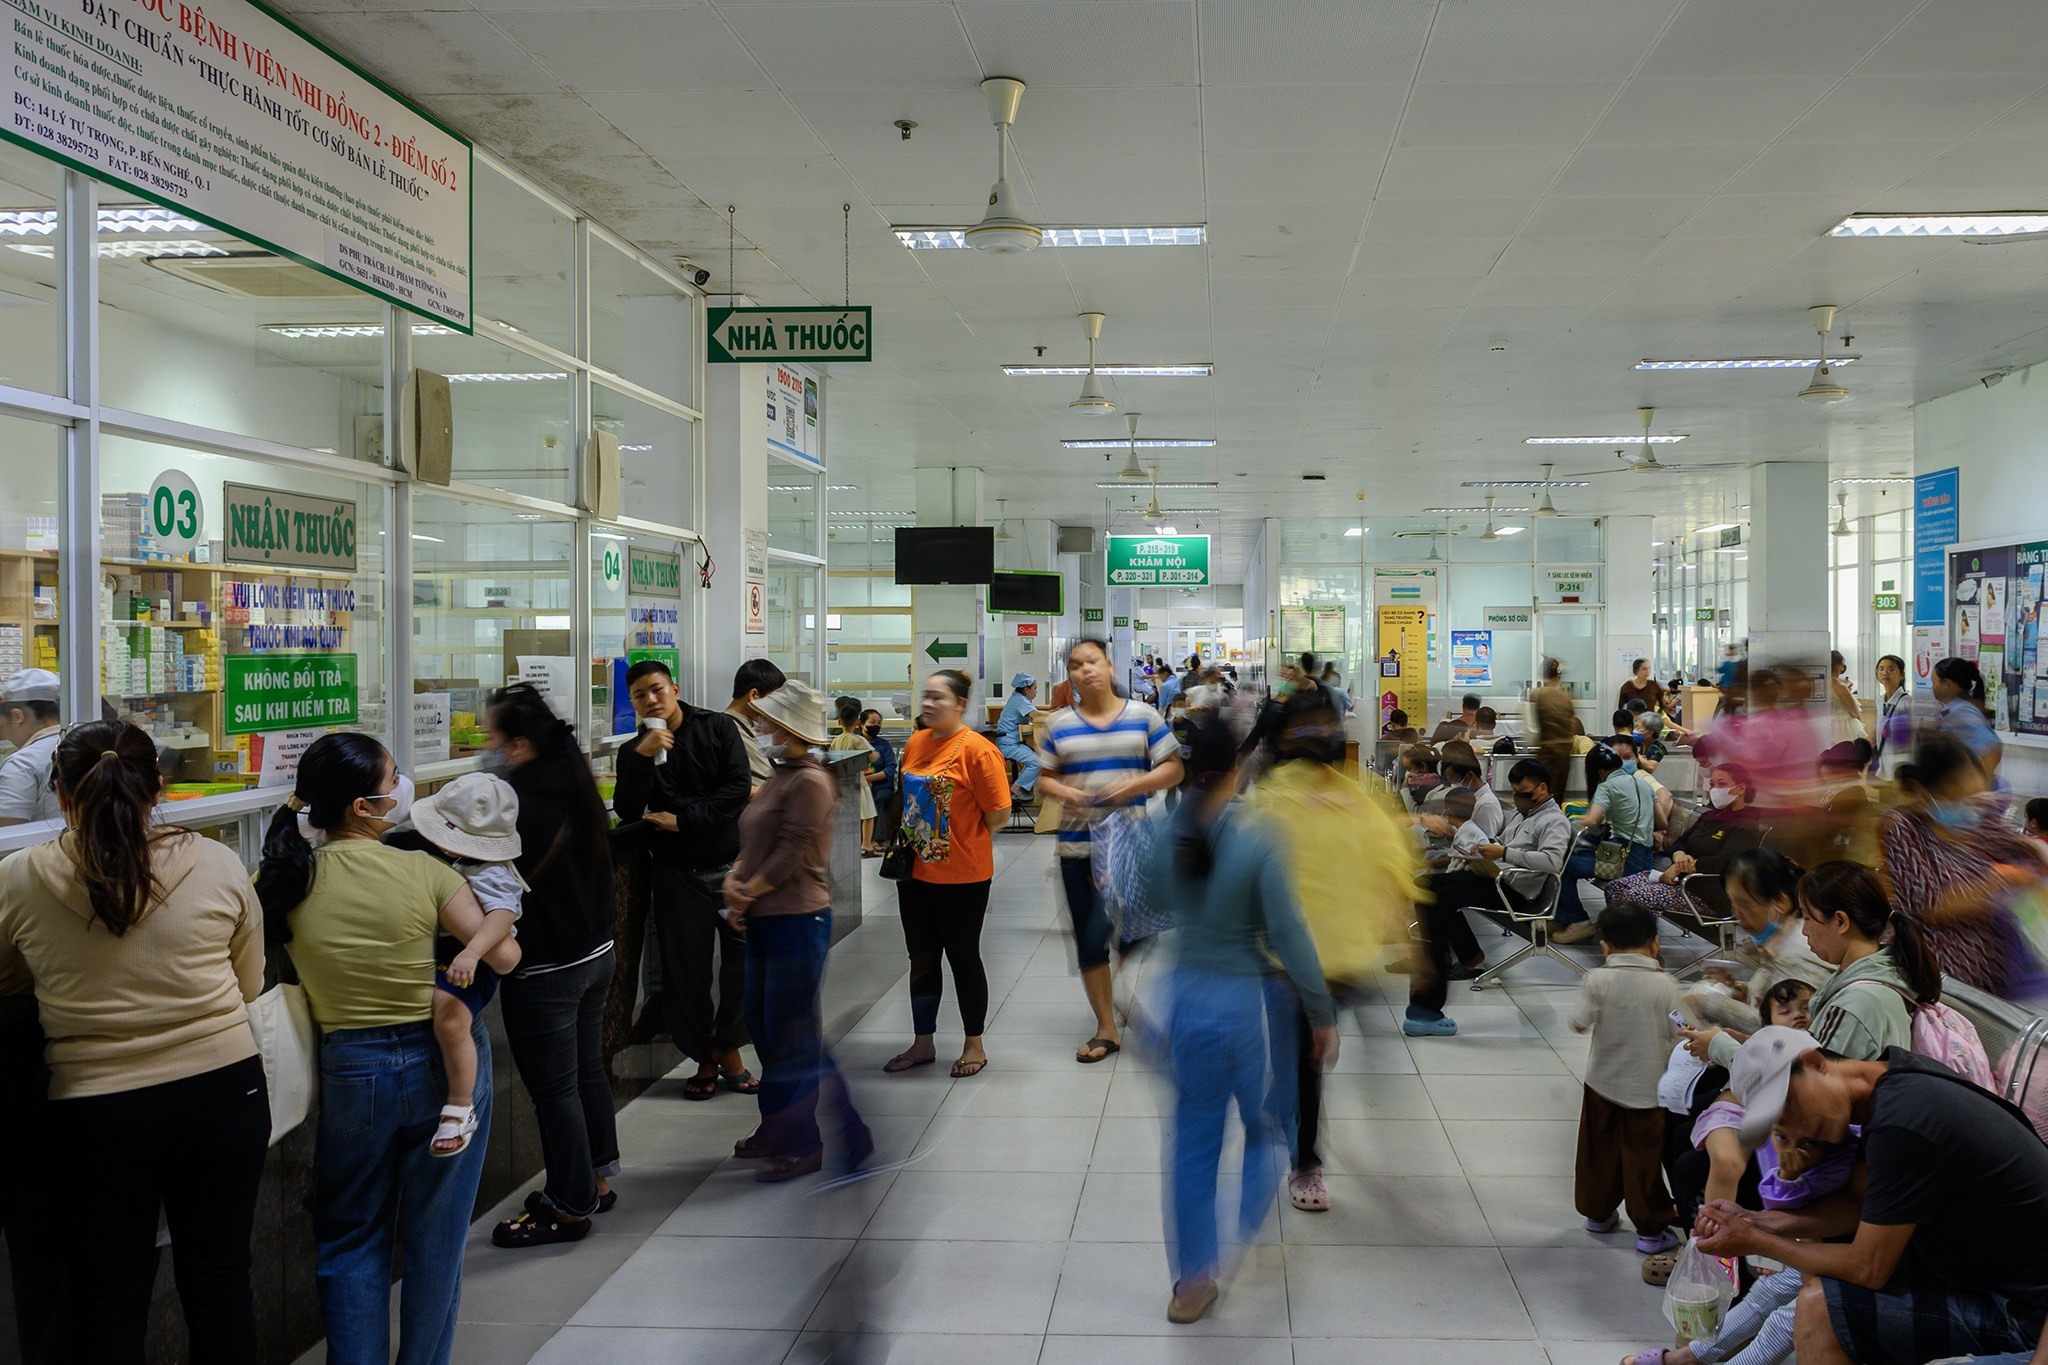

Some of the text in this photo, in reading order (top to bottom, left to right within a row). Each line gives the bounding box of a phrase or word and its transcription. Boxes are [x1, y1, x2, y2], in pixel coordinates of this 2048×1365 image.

[44, 8, 142, 72] VI KINH DOANH:
[14, 18, 33, 39] Bán
[35, 29, 43, 45] lẻ
[46, 37, 71, 59] thuốc
[73, 50, 89, 69] hóa
[137, 85, 157, 103] dược
[158, 94, 175, 114] liệu,
[176, 105, 197, 124] thuốc
[198, 115, 208, 129] cổ
[208, 122, 234, 144] truyền,
[235, 135, 249, 150] sinh
[250, 143, 268, 160] phẩm
[14, 41, 37, 64] Kinh
[39, 55, 66, 79] doanh
[68, 70, 90, 93] dạng
[91, 83, 110, 101] phối
[112, 91, 128, 111] hợp
[129, 102, 138, 114] có
[140, 108, 160, 125] chứa
[161, 117, 180, 135] dược
[181, 127, 197, 143] chất
[199, 137, 211, 152] gây
[213, 144, 239, 165] nghiện;
[81, 0, 120, 30] ĐẠT
[124, 18, 184, 66] CHUẨN
[188, 54, 239, 96] “THỰC
[242, 84, 282, 121] HÀNH
[284, 108, 309, 136] TỐT
[312, 125, 329, 147] CƠ
[330, 134, 345, 156] SỞ
[347, 145, 370, 171] BÁN
[372, 159, 386, 180] LẺ
[388, 169, 429, 201] THUỐC”
[178, 2, 237, 62] BỆNH
[242, 41, 287, 91] VIỆN
[291, 72, 322, 112] NHI
[326, 90, 370, 140] ĐỒNG
[373, 124, 380, 147] 2
[391, 134, 428, 176] ĐIỂM
[431, 157, 447, 185] SỐ
[449, 171, 456, 191] 2
[14, 64, 28, 81] Cơ
[29, 72, 40, 87] sở
[42, 78, 62, 99] kinh
[64, 90, 90, 112] doanh
[92, 104, 116, 124] thuốc
[117, 116, 135, 135] độc,
[136, 125, 158, 144] thuốc
[160, 137, 181, 157] trong
[182, 146, 201, 164] danh
[202, 158, 218, 172] mục
[218, 164, 240, 184] thuốc,
[14, 91, 210, 191] ĐC: 14 LÝ TỰ TRỌNG, P. BẾN NGHÉ, Q. 1
[14, 112, 188, 198] ĐT: 028 38295723 FAT: 028 38295723
[339, 243, 348, 255] DS
[339, 258, 355, 274] GCN:
[398, 285, 412, 299] HCM
[427, 298, 441, 311] GCN:
[728, 314, 864, 350] NHÀ THUỐC
[777, 368, 790, 388] 1900
[154, 486, 197, 539] 03
[230, 496, 354, 558] NHẬN THUỐC
[604, 551, 620, 580] 04
[1130, 556, 1186, 568] KHÁM NỘI
[1148, 545, 1159, 553] 315
[1164, 545, 1176, 553] 319
[632, 555, 679, 590] NHẬN THUỐC
[1125, 572, 1136, 580] 320
[1142, 572, 1152, 580] 331
[1170, 572, 1182, 580] 301
[1186, 572, 1198, 580] 314
[233, 576, 354, 612] VUI LÒNG KIỂM TRA THUỐC
[1877, 596, 1896, 608] 303
[1088, 611, 1102, 619] 318
[1488, 614, 1507, 622] PHÒNG
[249, 617, 280, 648] TRƯỚC
[284, 626, 300, 648] KHI
[302, 619, 318, 648] RỜI
[244, 662, 342, 690] KHÔNG ĐỔI TRẢ
[235, 691, 350, 723] SAU KHI KIỂM TRA
